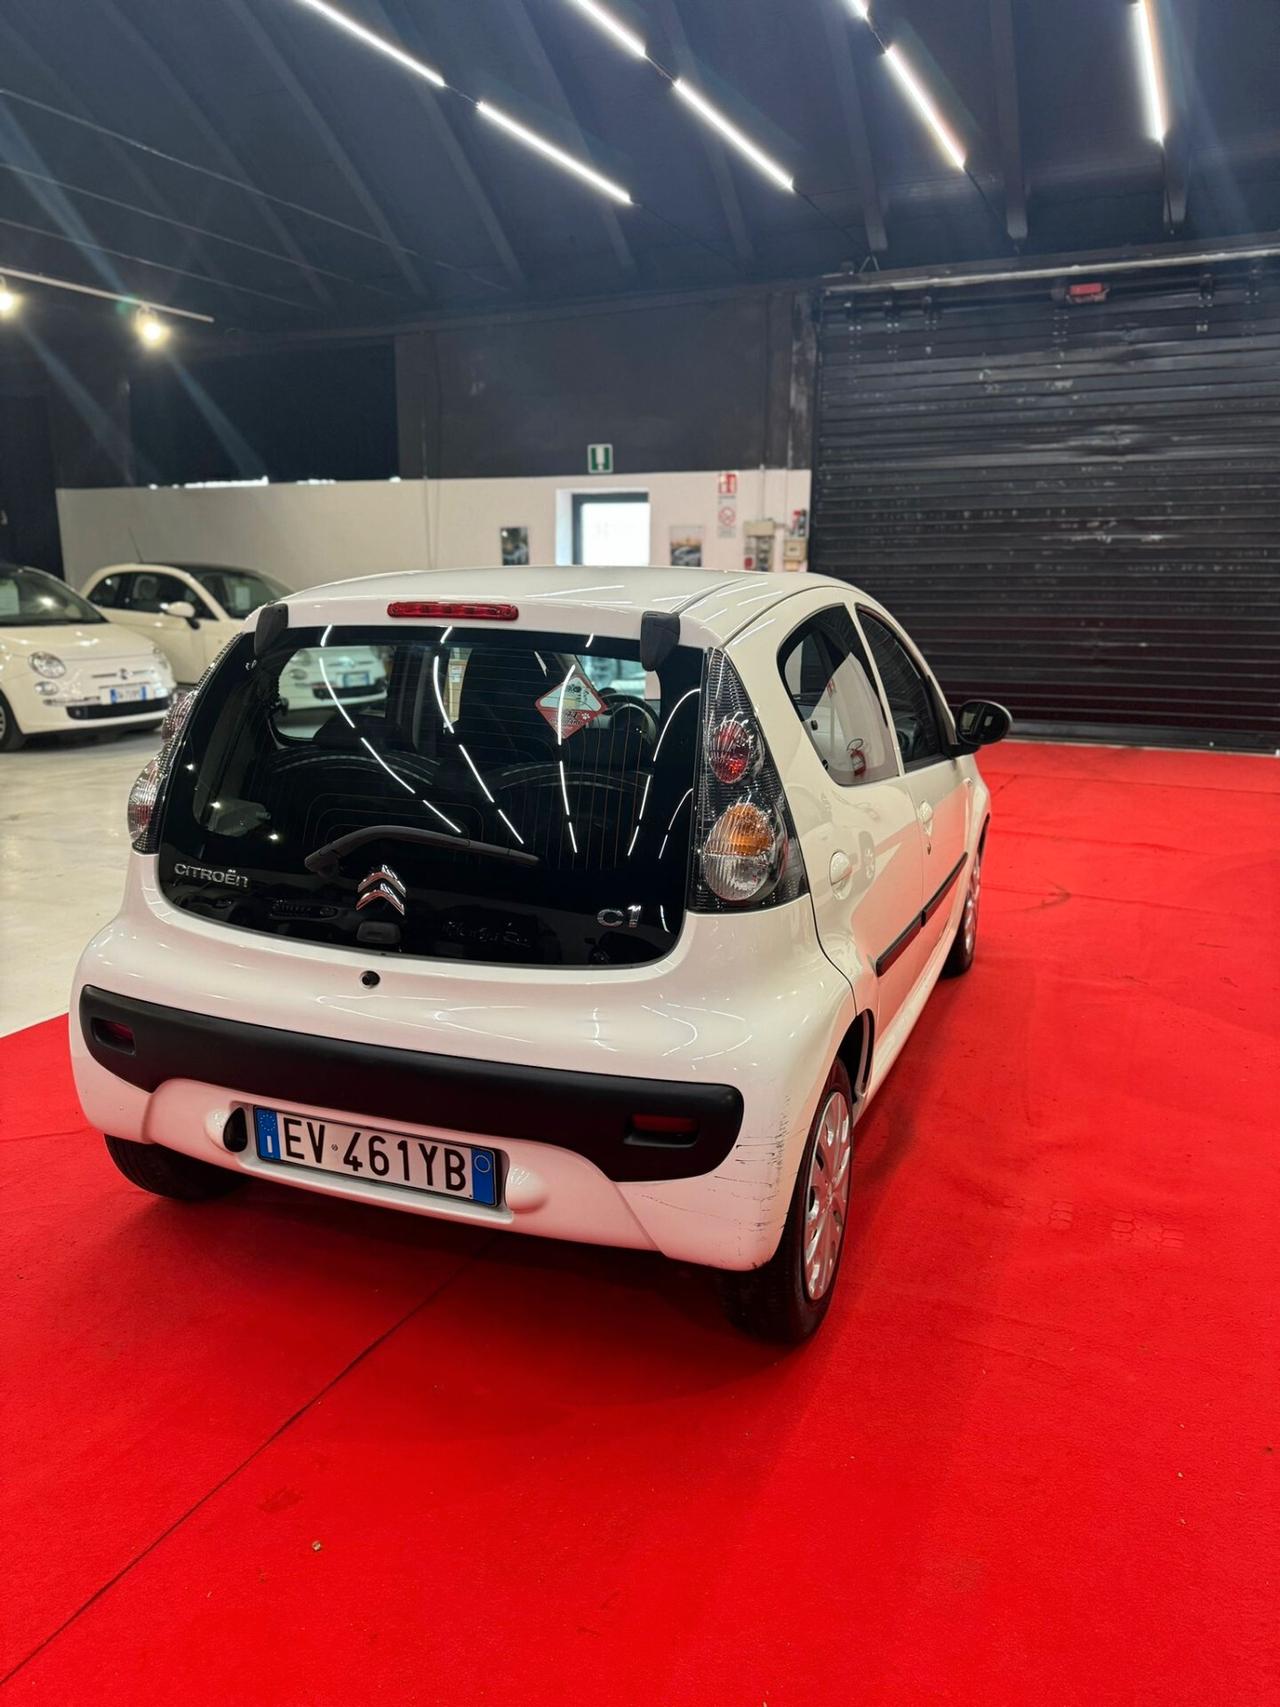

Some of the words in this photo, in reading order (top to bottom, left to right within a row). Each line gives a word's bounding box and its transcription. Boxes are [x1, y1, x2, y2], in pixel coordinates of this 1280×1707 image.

[597, 905, 641, 928] C1
[266, 1135, 273, 1153] I
[282, 1116, 325, 1164] EV
[343, 1132, 466, 1191] 461YB
